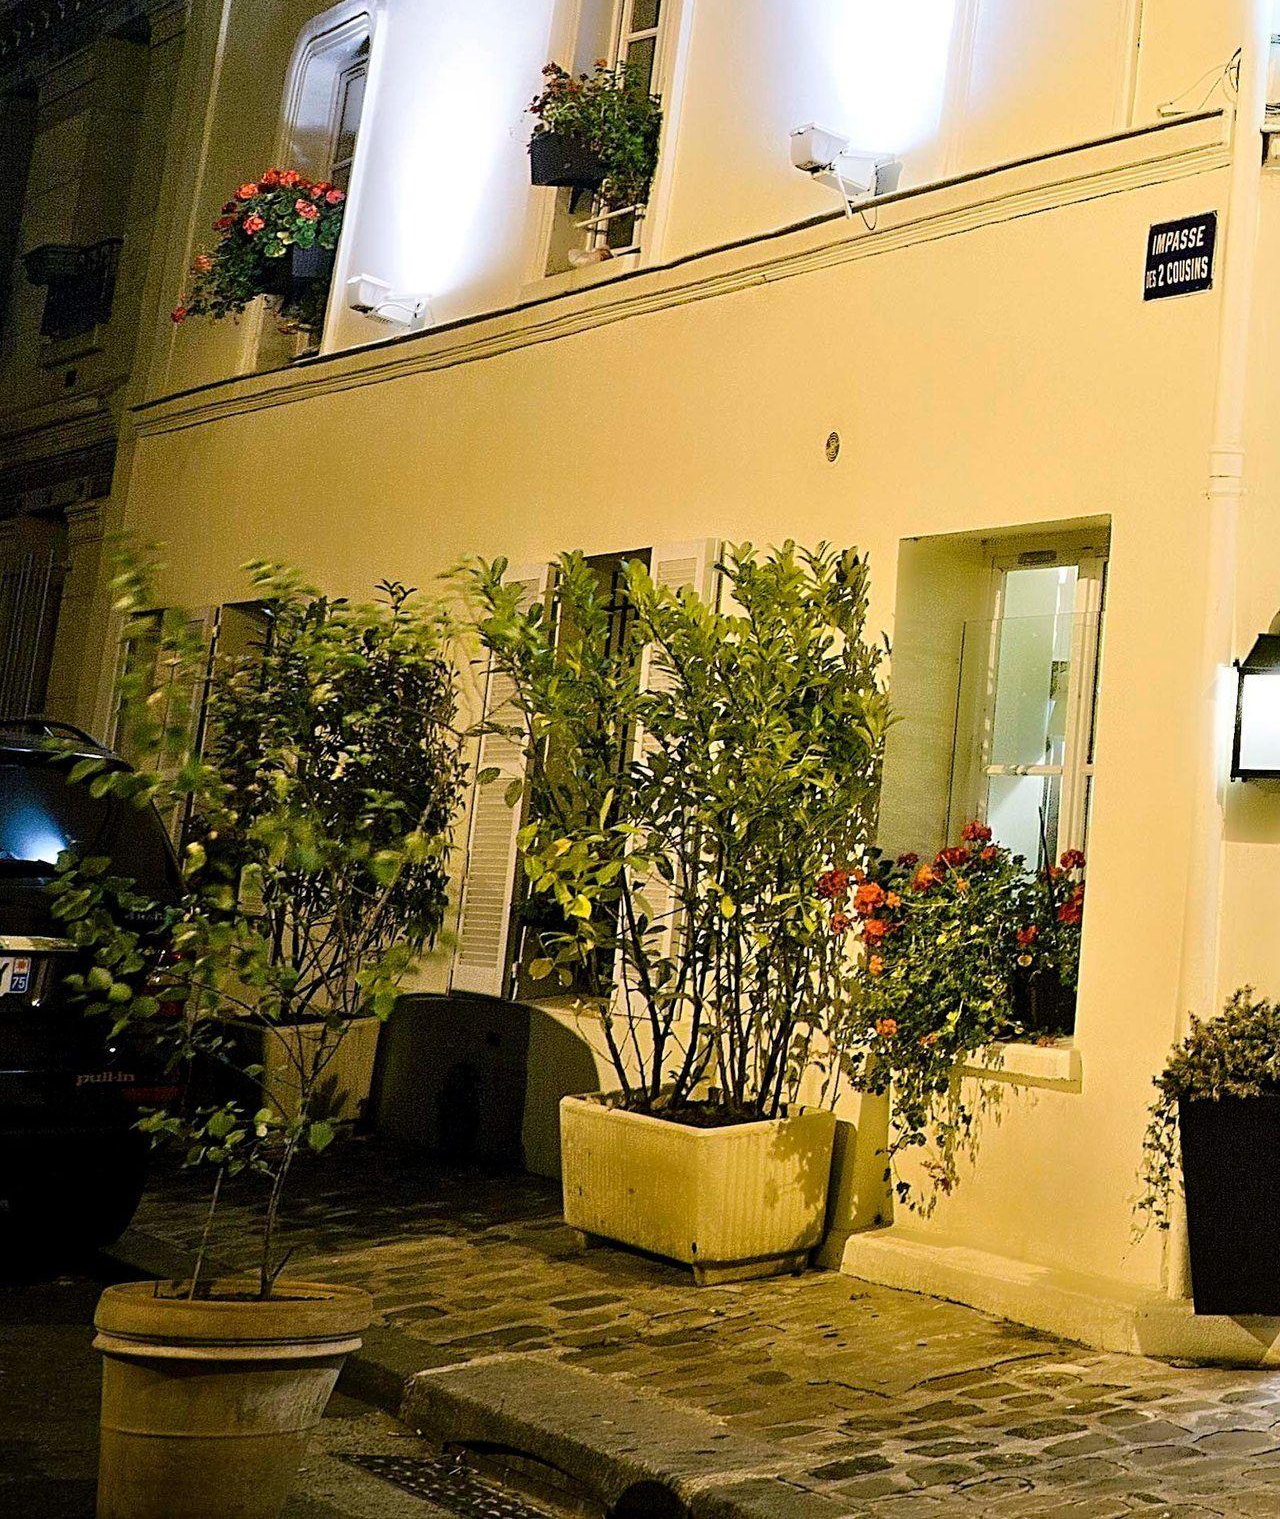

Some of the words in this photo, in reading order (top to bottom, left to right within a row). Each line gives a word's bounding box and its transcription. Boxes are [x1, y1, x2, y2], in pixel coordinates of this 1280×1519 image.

[1151, 225, 1206, 256] IMPASSE
[1158, 263, 1165, 287] 2
[1166, 256, 1209, 285] COUSINS
[11, 975, 26, 990] 75
